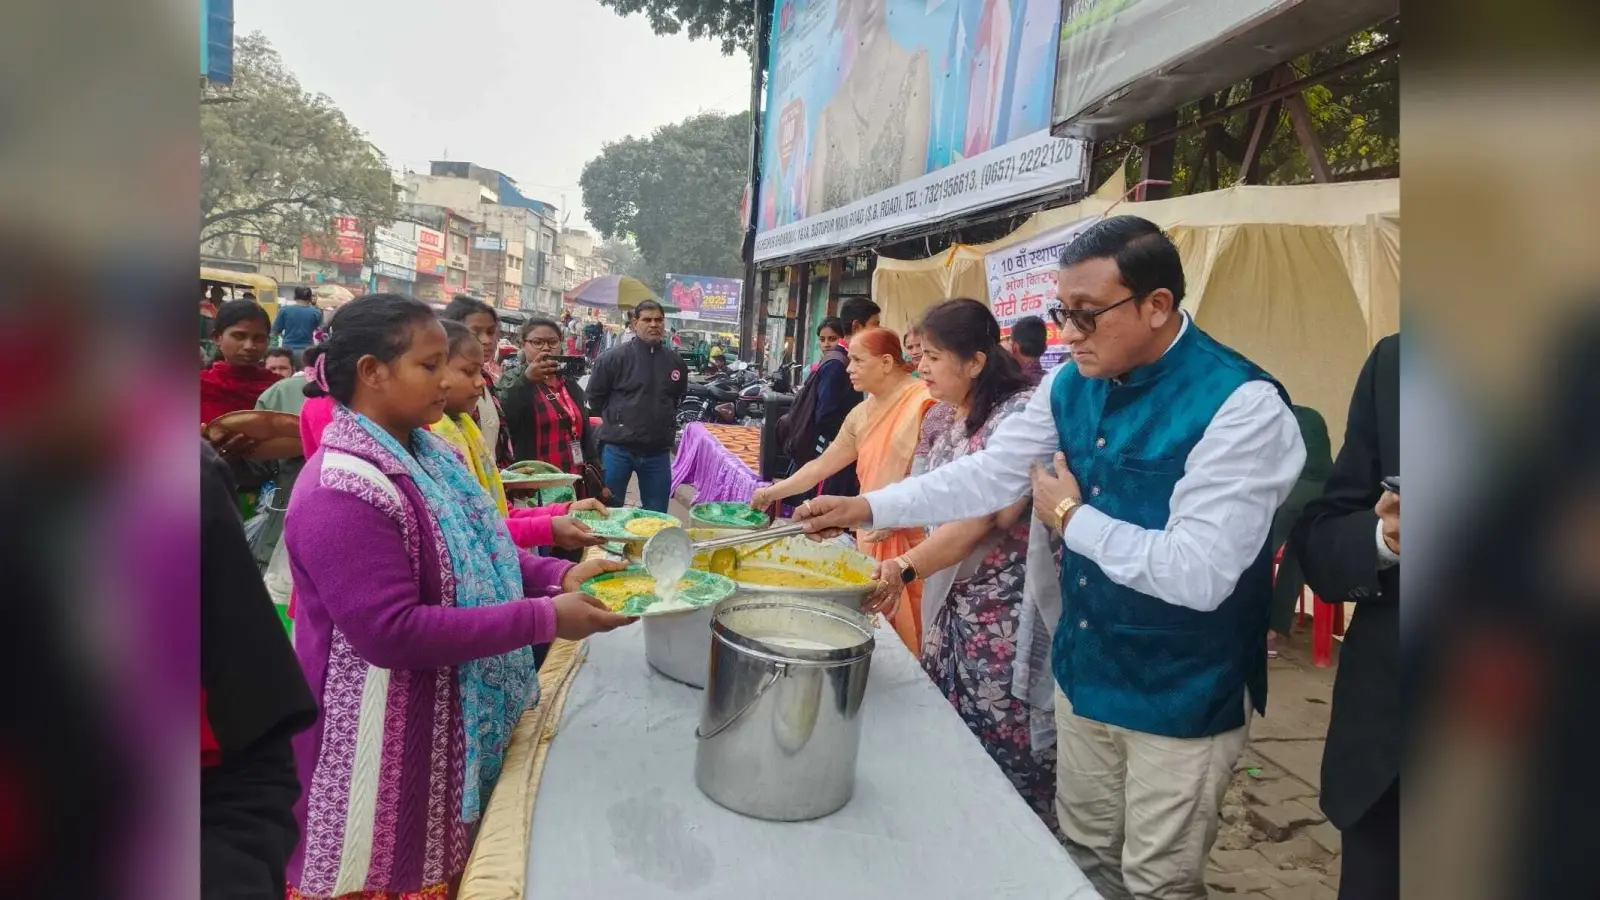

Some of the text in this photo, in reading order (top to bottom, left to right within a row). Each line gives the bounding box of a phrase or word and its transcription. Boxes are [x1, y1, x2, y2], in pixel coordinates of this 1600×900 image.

[905, 190, 917, 211] TEL
[980, 155, 1016, 191] (0657)
[1018, 138, 1073, 175] 2222126
[1001, 257, 1014, 273] 10
[703, 295, 727, 305] 2025
[994, 293, 1017, 317] रोटी
